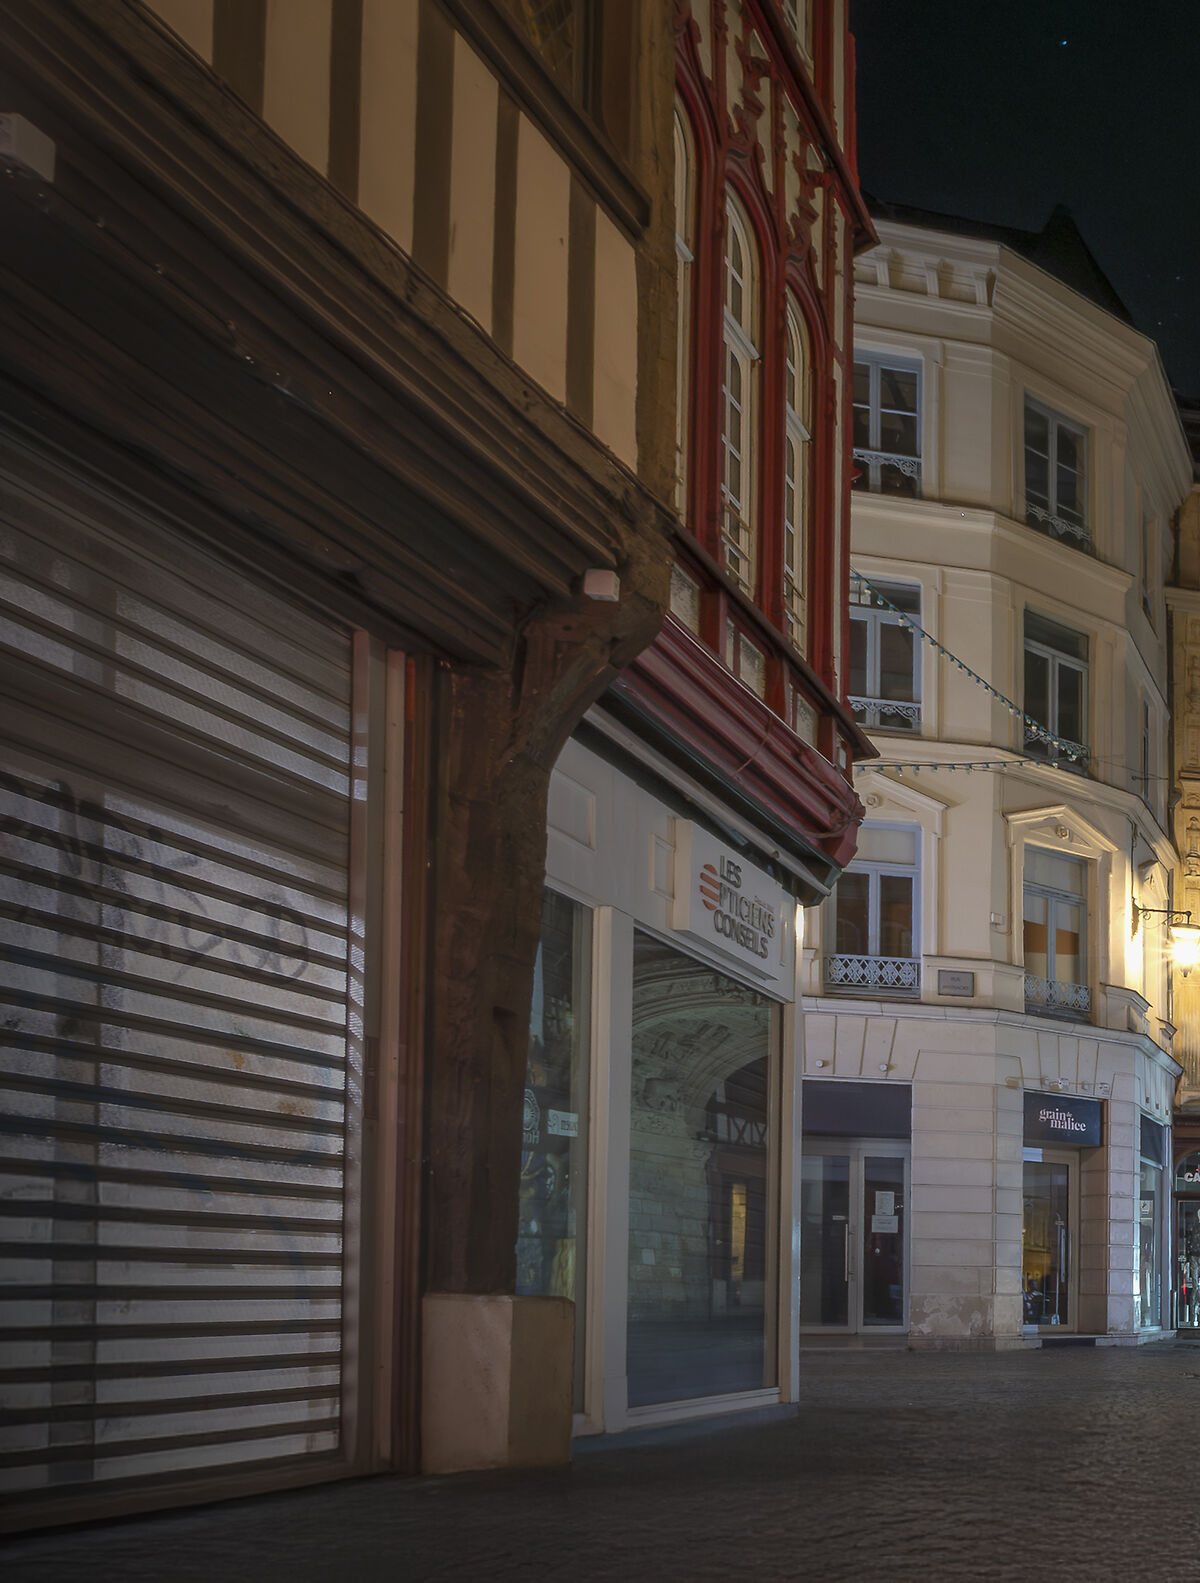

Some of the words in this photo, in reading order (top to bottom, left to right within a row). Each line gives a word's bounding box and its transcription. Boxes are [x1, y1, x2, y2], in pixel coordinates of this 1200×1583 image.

[720, 855, 742, 888] LES
[714, 909, 768, 959] CONSEILS
[1039, 1108, 1066, 1122] grain
[1051, 1118, 1087, 1131] malice
